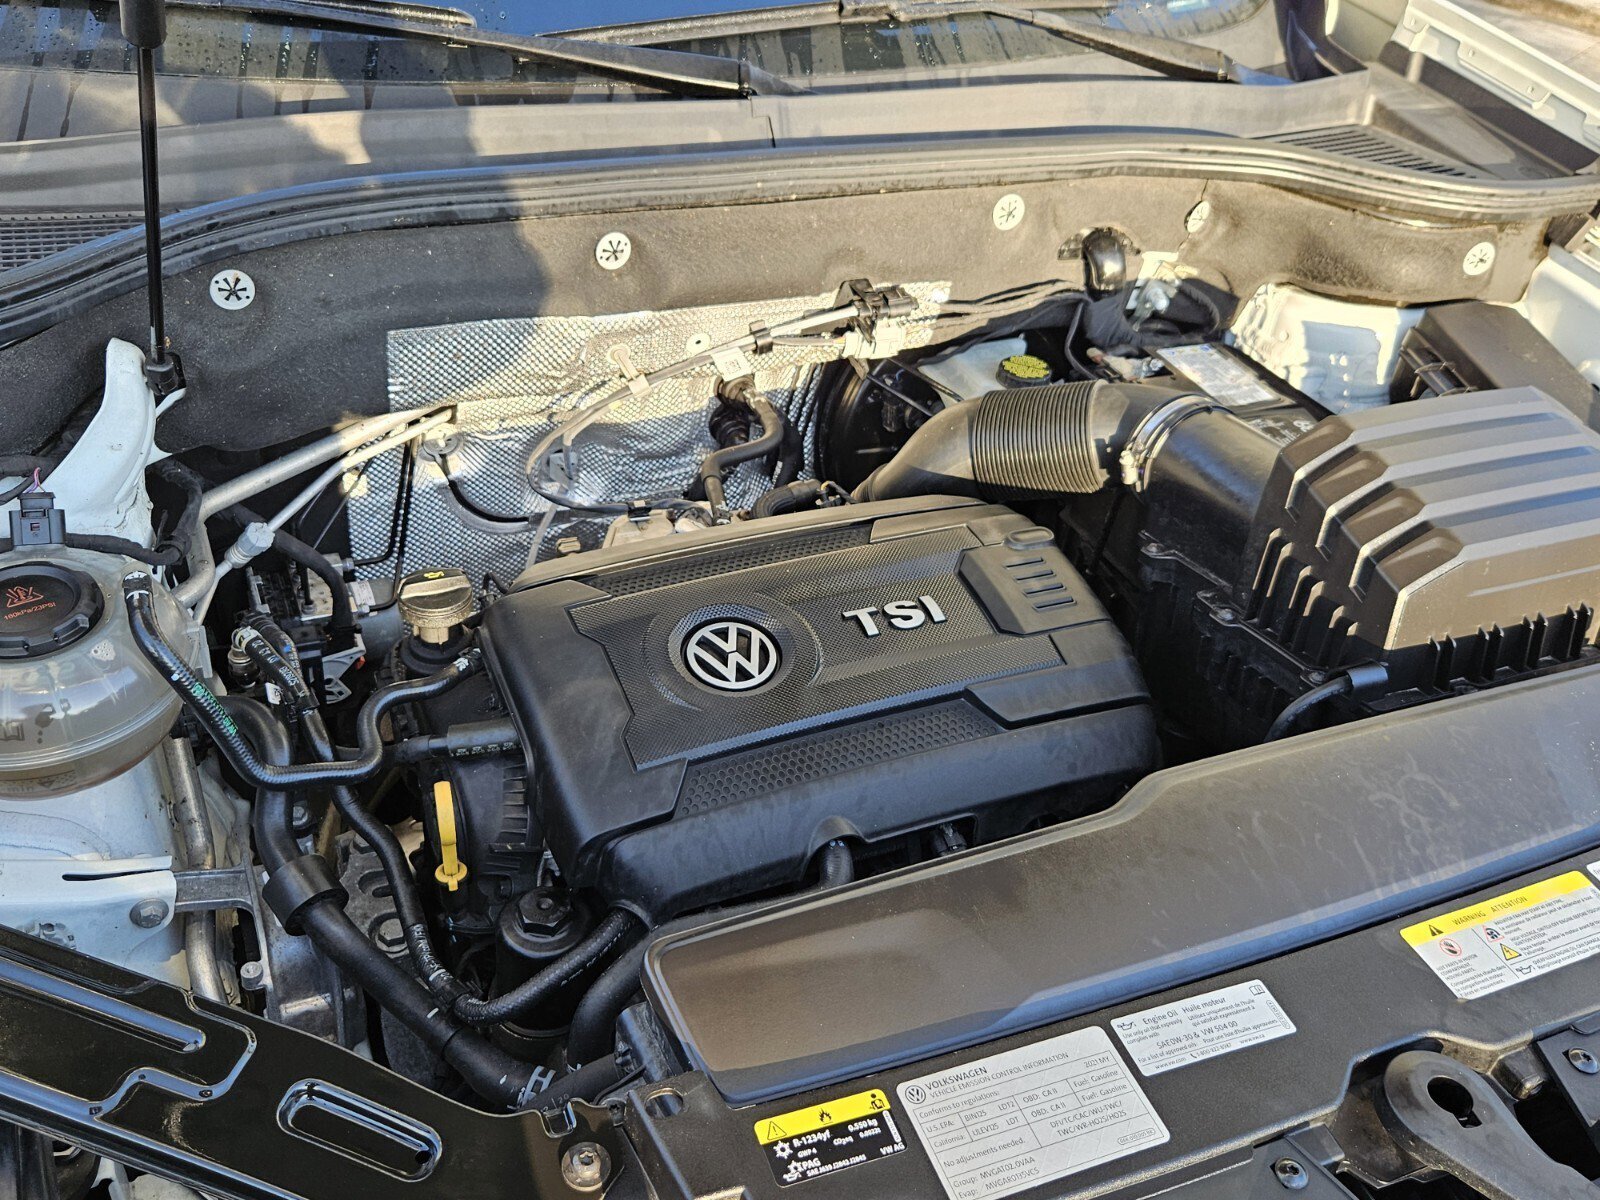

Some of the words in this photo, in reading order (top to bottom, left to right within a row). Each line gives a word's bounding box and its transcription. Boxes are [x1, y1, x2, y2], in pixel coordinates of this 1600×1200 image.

[842, 595, 947, 637] TSI
[1452, 910, 1486, 925] WARNING
[1490, 895, 1528, 912] ATTENTION
[1182, 1004, 1201, 1013] Huile
[1200, 997, 1226, 1007] moteur
[1142, 1013, 1168, 1025] Engine
[1166, 1009, 1178, 1017] Oil
[1200, 1027, 1215, 1035] VW
[1214, 1023, 1230, 1032] 504
[925, 1067, 987, 1090] VOLKSWAGEN
[929, 1085, 957, 1097] VEHICLE
[957, 1075, 990, 1089] EMISSION
[990, 1066, 1021, 1079] CONTROL
[1022, 1052, 1068, 1070] INFORMATION
[1073, 1077, 1090, 1087] Fuel:
[1090, 1068, 1118, 1082] Gasoline
[1022, 1092, 1040, 1103] OBD:
[1041, 1088, 1053, 1097] CA
[1081, 1091, 1099, 1101] Fuel:
[1098, 1082, 1127, 1095] Gasoline
[919, 1103, 952, 1118] Conforms
[952, 1100, 961, 1108] to
[960, 1089, 1000, 1107] regulations:
[997, 1100, 1015, 1110] LDT2
[1030, 1107, 1049, 1117] OBD:
[1049, 1102, 1061, 1111] CA
[964, 1109, 986, 1121] BIN125
[1006, 1116, 1020, 1125] LDT
[792, 1130, 831, 1148] R-1234yf
[847, 1120, 867, 1131] 0.550
[866, 1117, 878, 1127] kg
[972, 1122, 999, 1136] ULEV125
[880, 1146, 893, 1154] VW
[892, 1142, 905, 1151] AG
[933, 1133, 966, 1148] California:
[943, 1159, 955, 1168] No
[954, 1145, 998, 1165] adjustments
[997, 1136, 1025, 1150] needed.
[801, 1158, 820, 1169] PAG
[953, 1174, 978, 1190] Group:
[958, 1187, 979, 1200] Evap:
